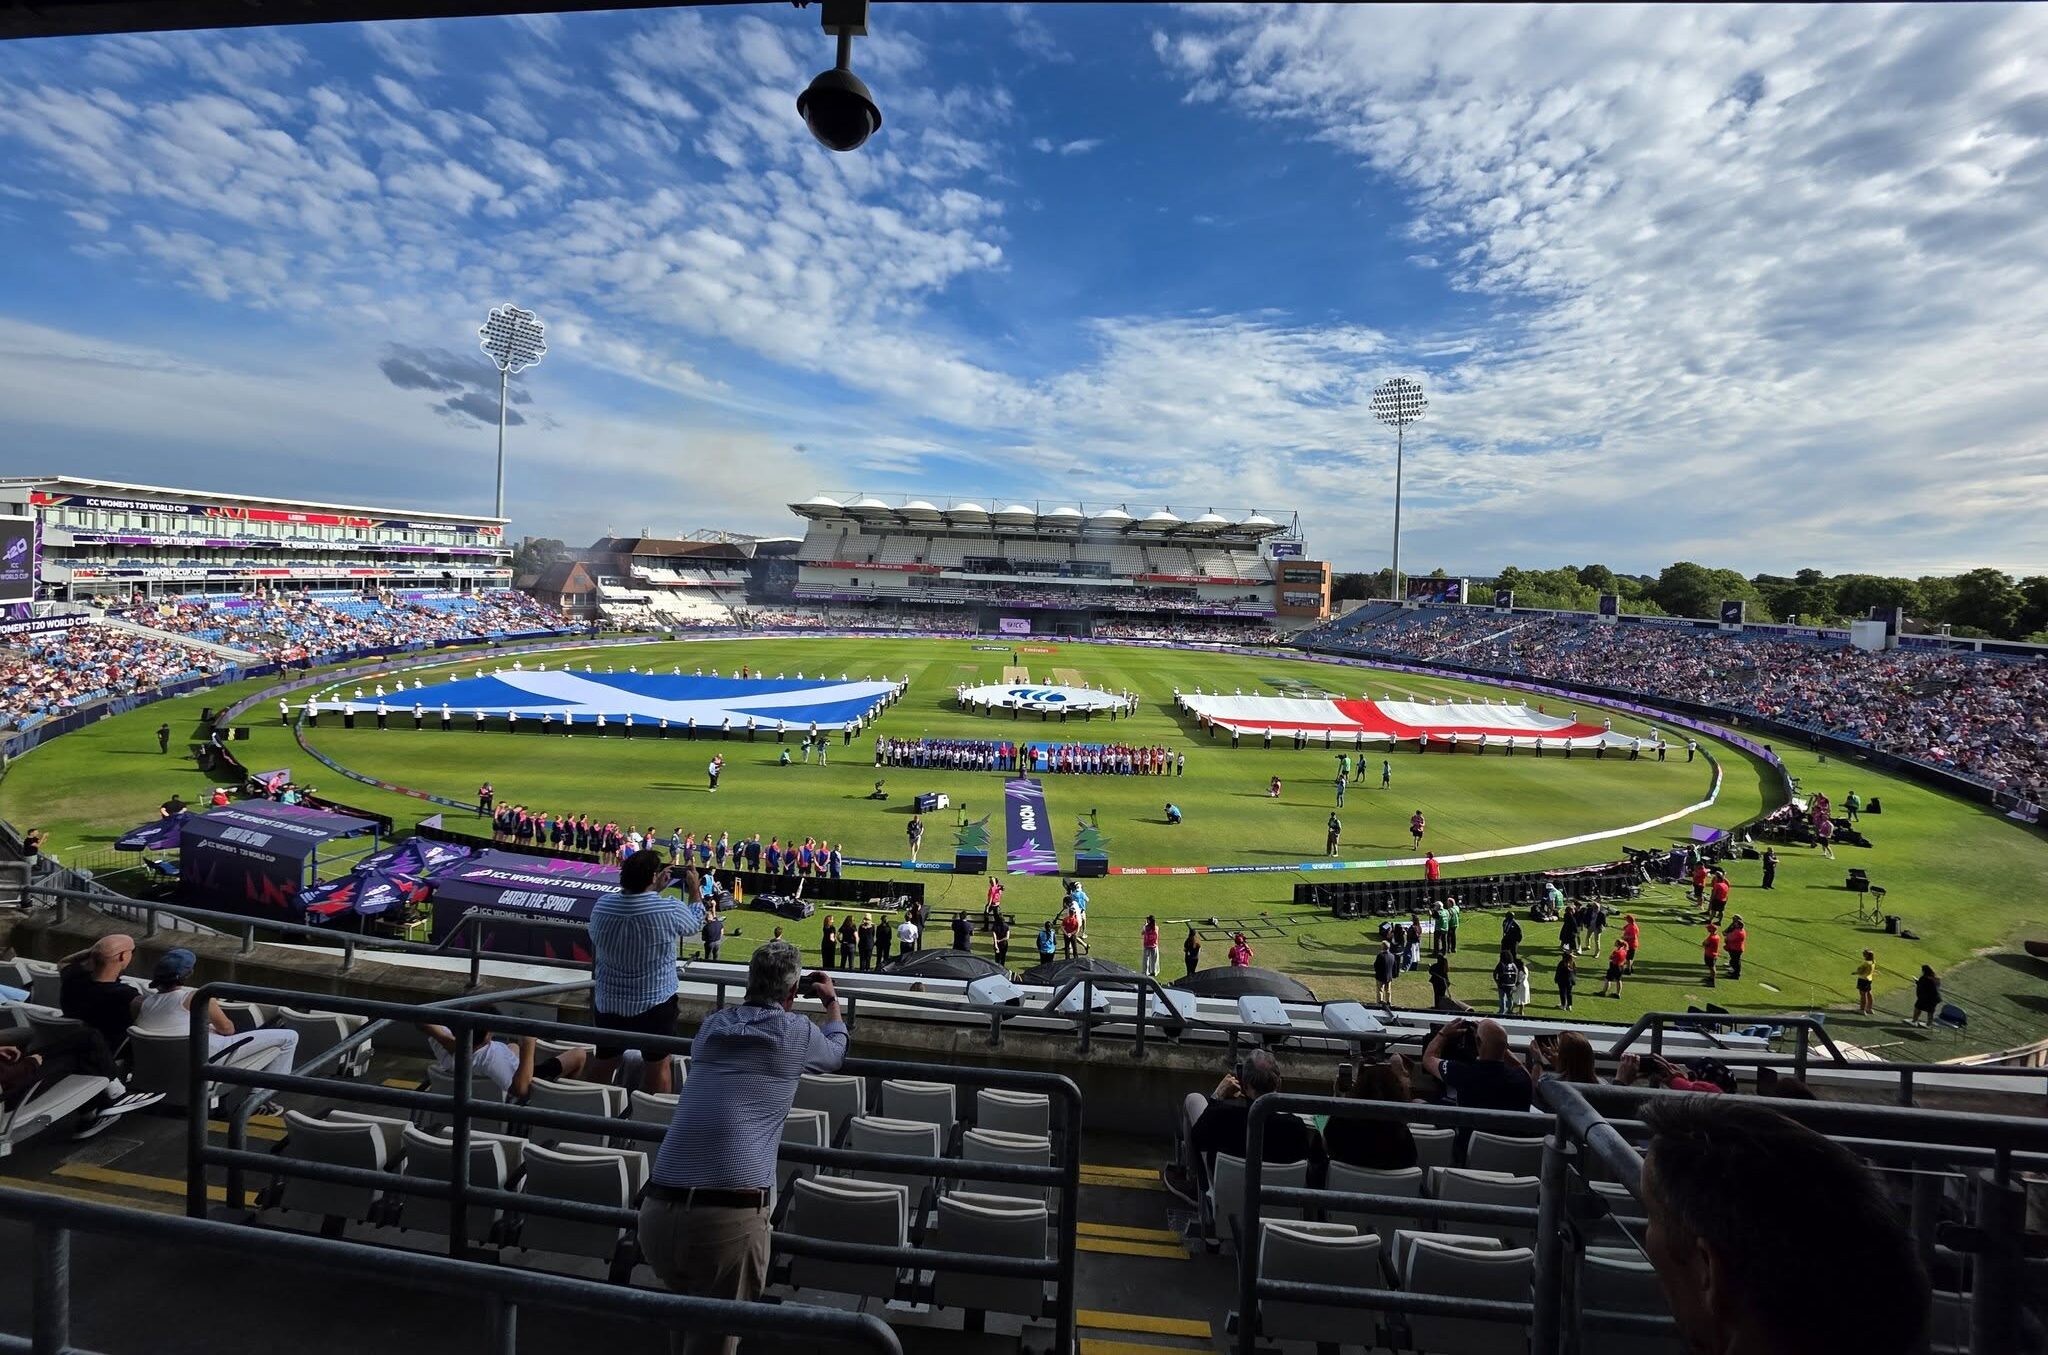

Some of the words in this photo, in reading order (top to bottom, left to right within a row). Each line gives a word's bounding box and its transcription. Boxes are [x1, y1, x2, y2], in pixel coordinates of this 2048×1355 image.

[100, 500, 135, 509] WOMEN'S
[135, 502, 148, 510] T20
[149, 503, 173, 511] WORLD
[174, 505, 188, 513] CUP
[0, 622, 31, 633] OMEN'S
[32, 620, 45, 630] T20
[46, 617, 75, 629] WORLD
[75, 616, 91, 625] CUP
[1640, 618, 1693, 627] T20WORLDCUP.COM
[489, 871, 511, 880] ICC
[509, 873, 560, 886] WOMEN'S
[559, 879, 579, 889] T20
[581, 882, 622, 894] WORLD
[498, 890, 529, 906] CATCH
[527, 892, 544, 908] THE
[543, 895, 577, 913] SPIRIT
[479, 907, 493, 916] ICC
